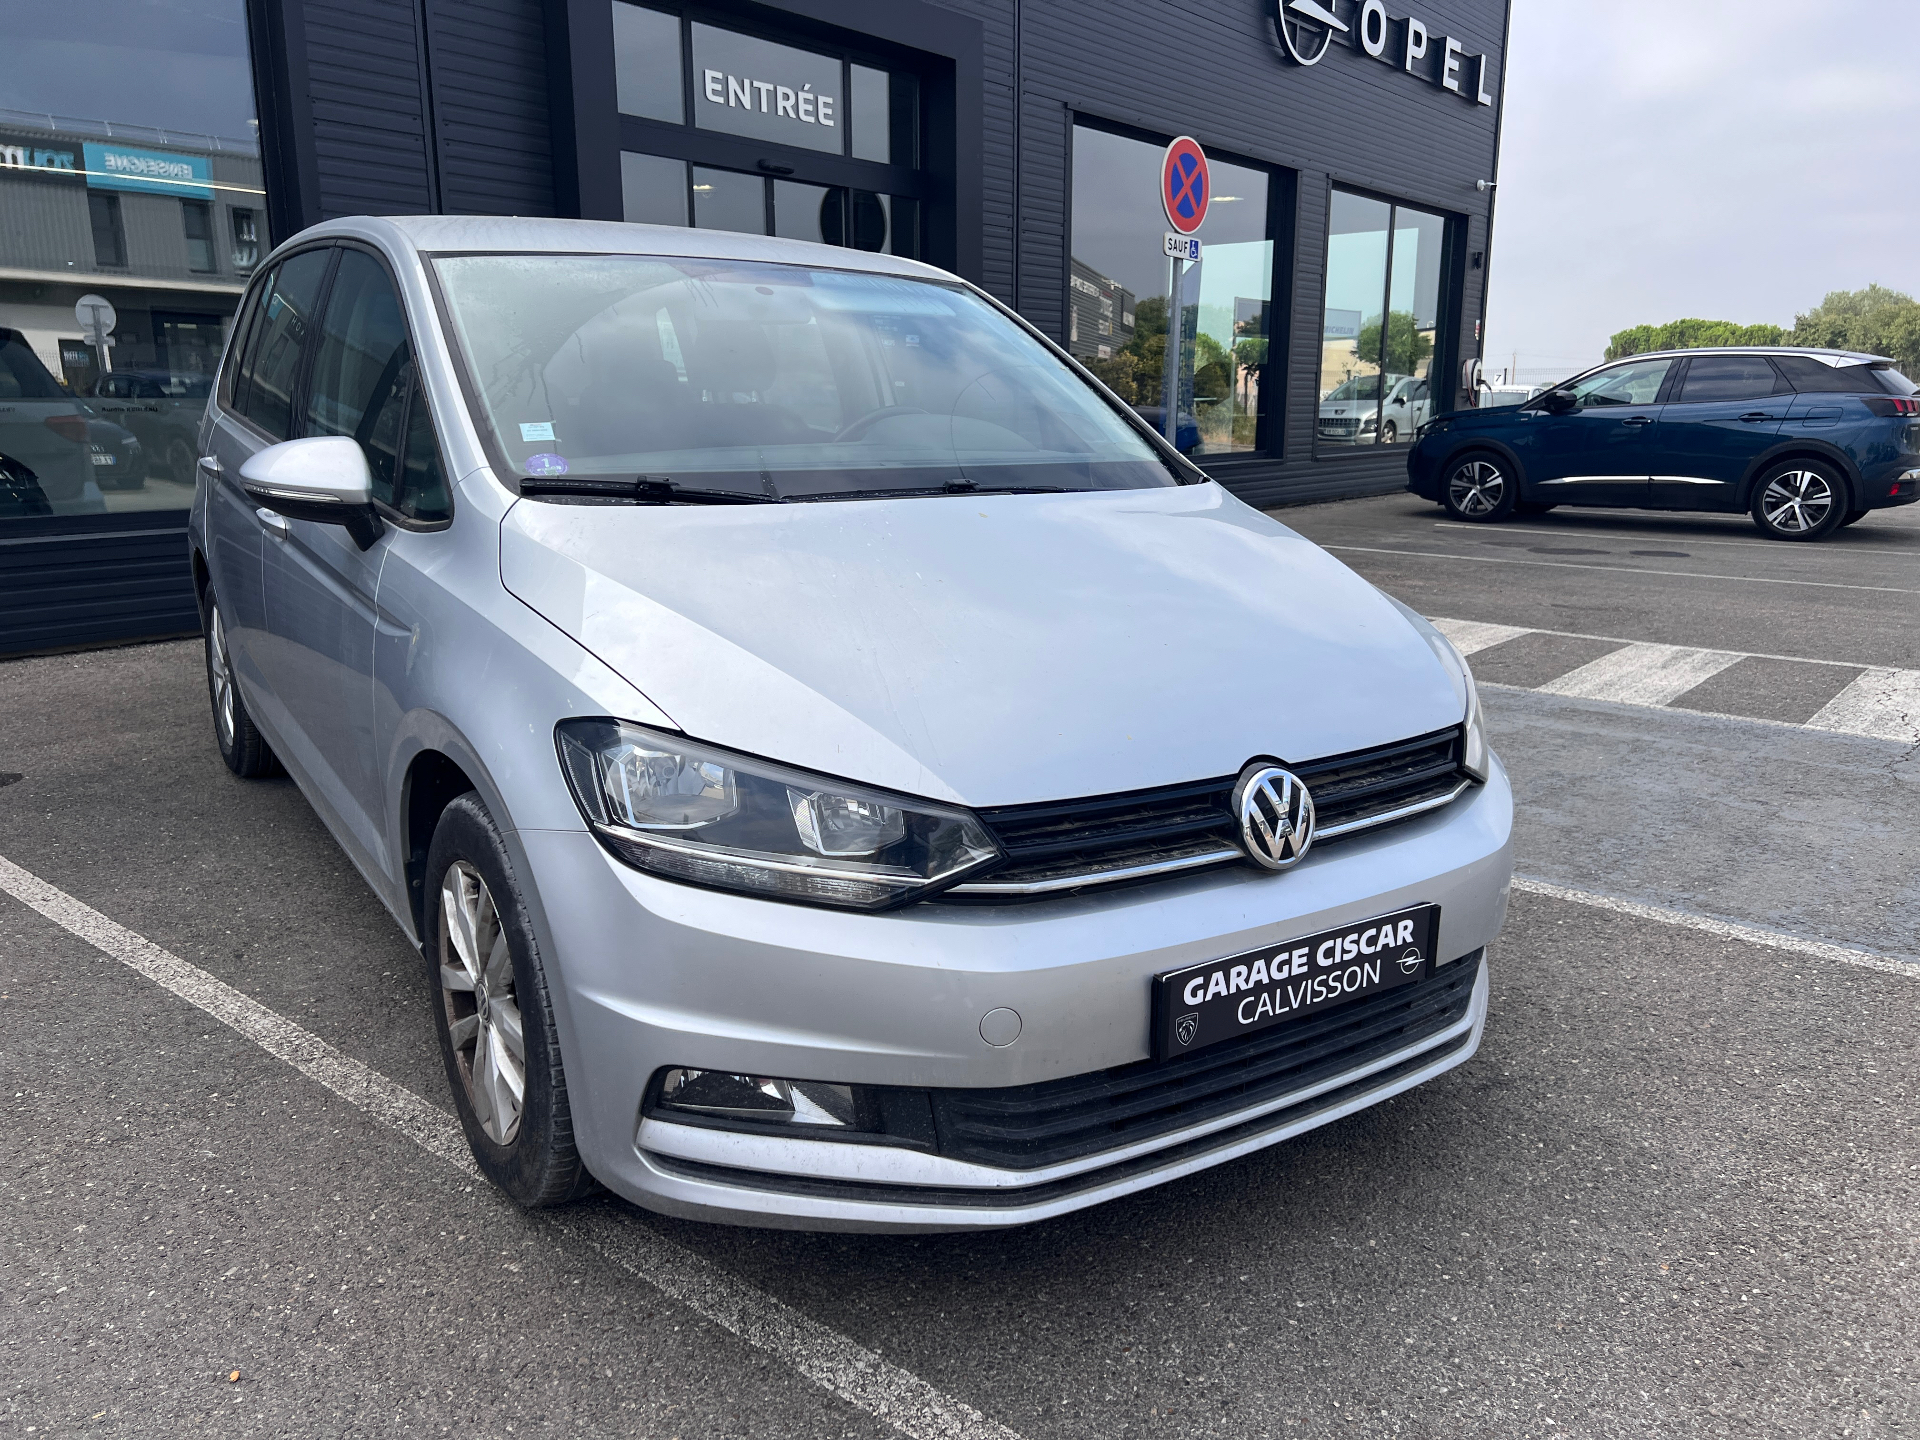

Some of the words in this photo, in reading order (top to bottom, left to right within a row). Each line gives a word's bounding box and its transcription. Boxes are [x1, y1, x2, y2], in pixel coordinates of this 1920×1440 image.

[1361, 0, 1491, 106] OPEL
[704, 69, 834, 127] ENTRÉE
[1168, 238, 1188, 254] SAUF
[1495, 374, 1502, 382] 7
[1183, 947, 1309, 1006] GARAGE
[1316, 919, 1414, 967] CISCAR
[1237, 959, 1381, 1025] CALVISSON
